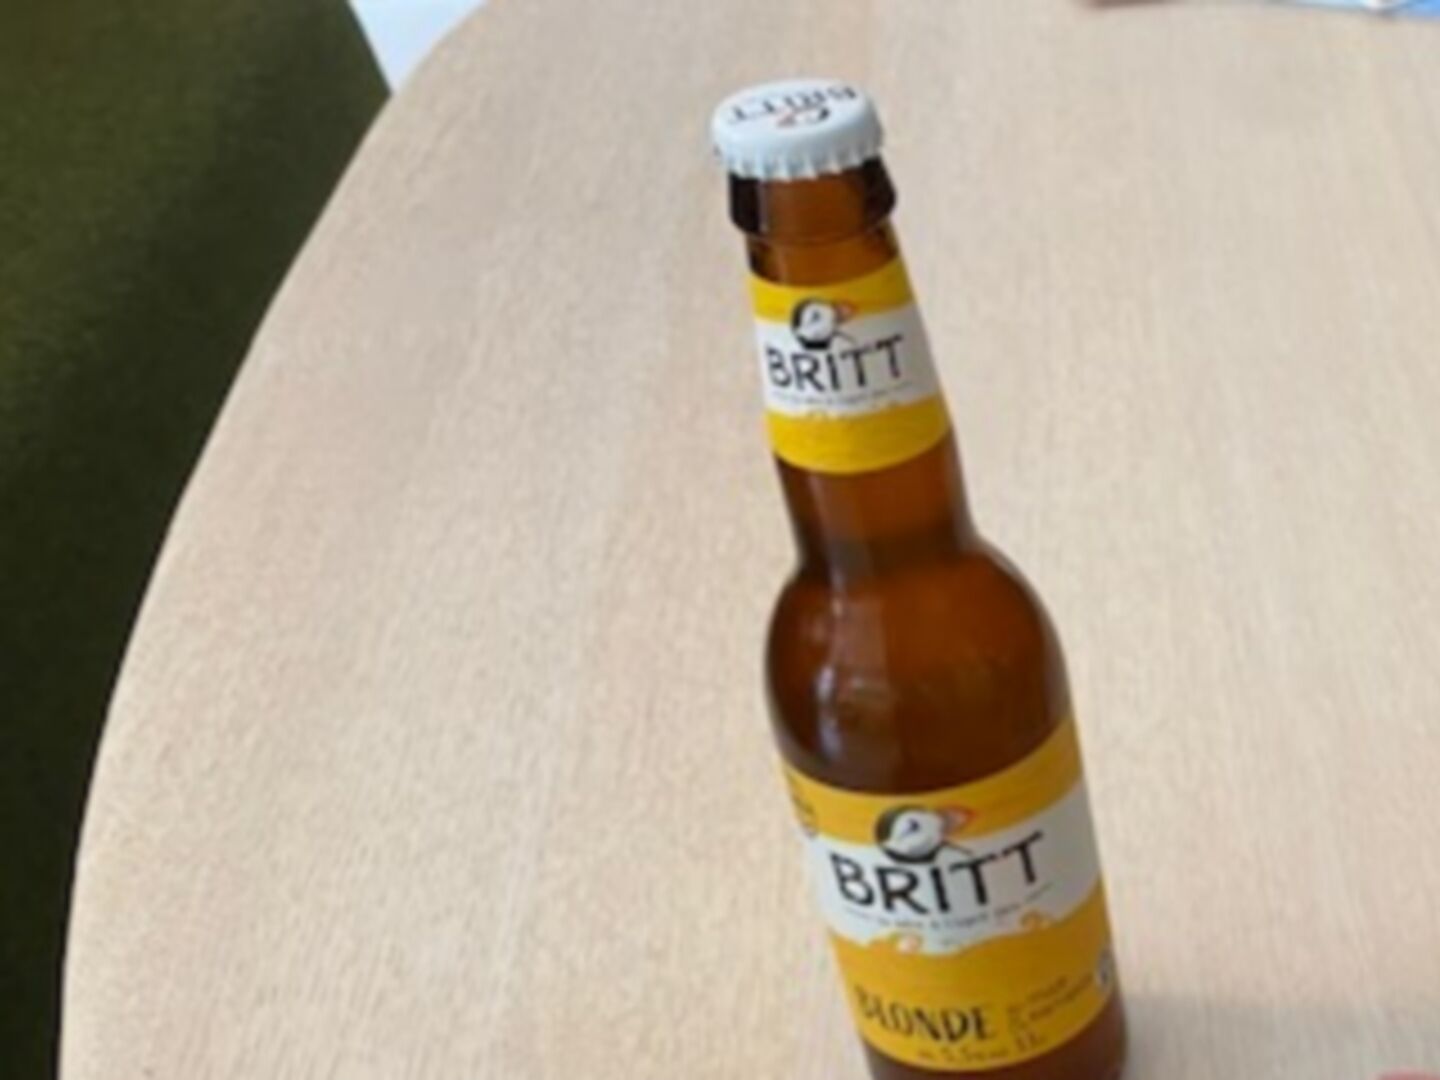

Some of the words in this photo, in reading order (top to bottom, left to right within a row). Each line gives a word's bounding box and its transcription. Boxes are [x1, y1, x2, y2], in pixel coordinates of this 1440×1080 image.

[764, 335, 906, 393] BRITT
[829, 829, 1044, 916] BRITT
[854, 982, 996, 1043] BLONDE
